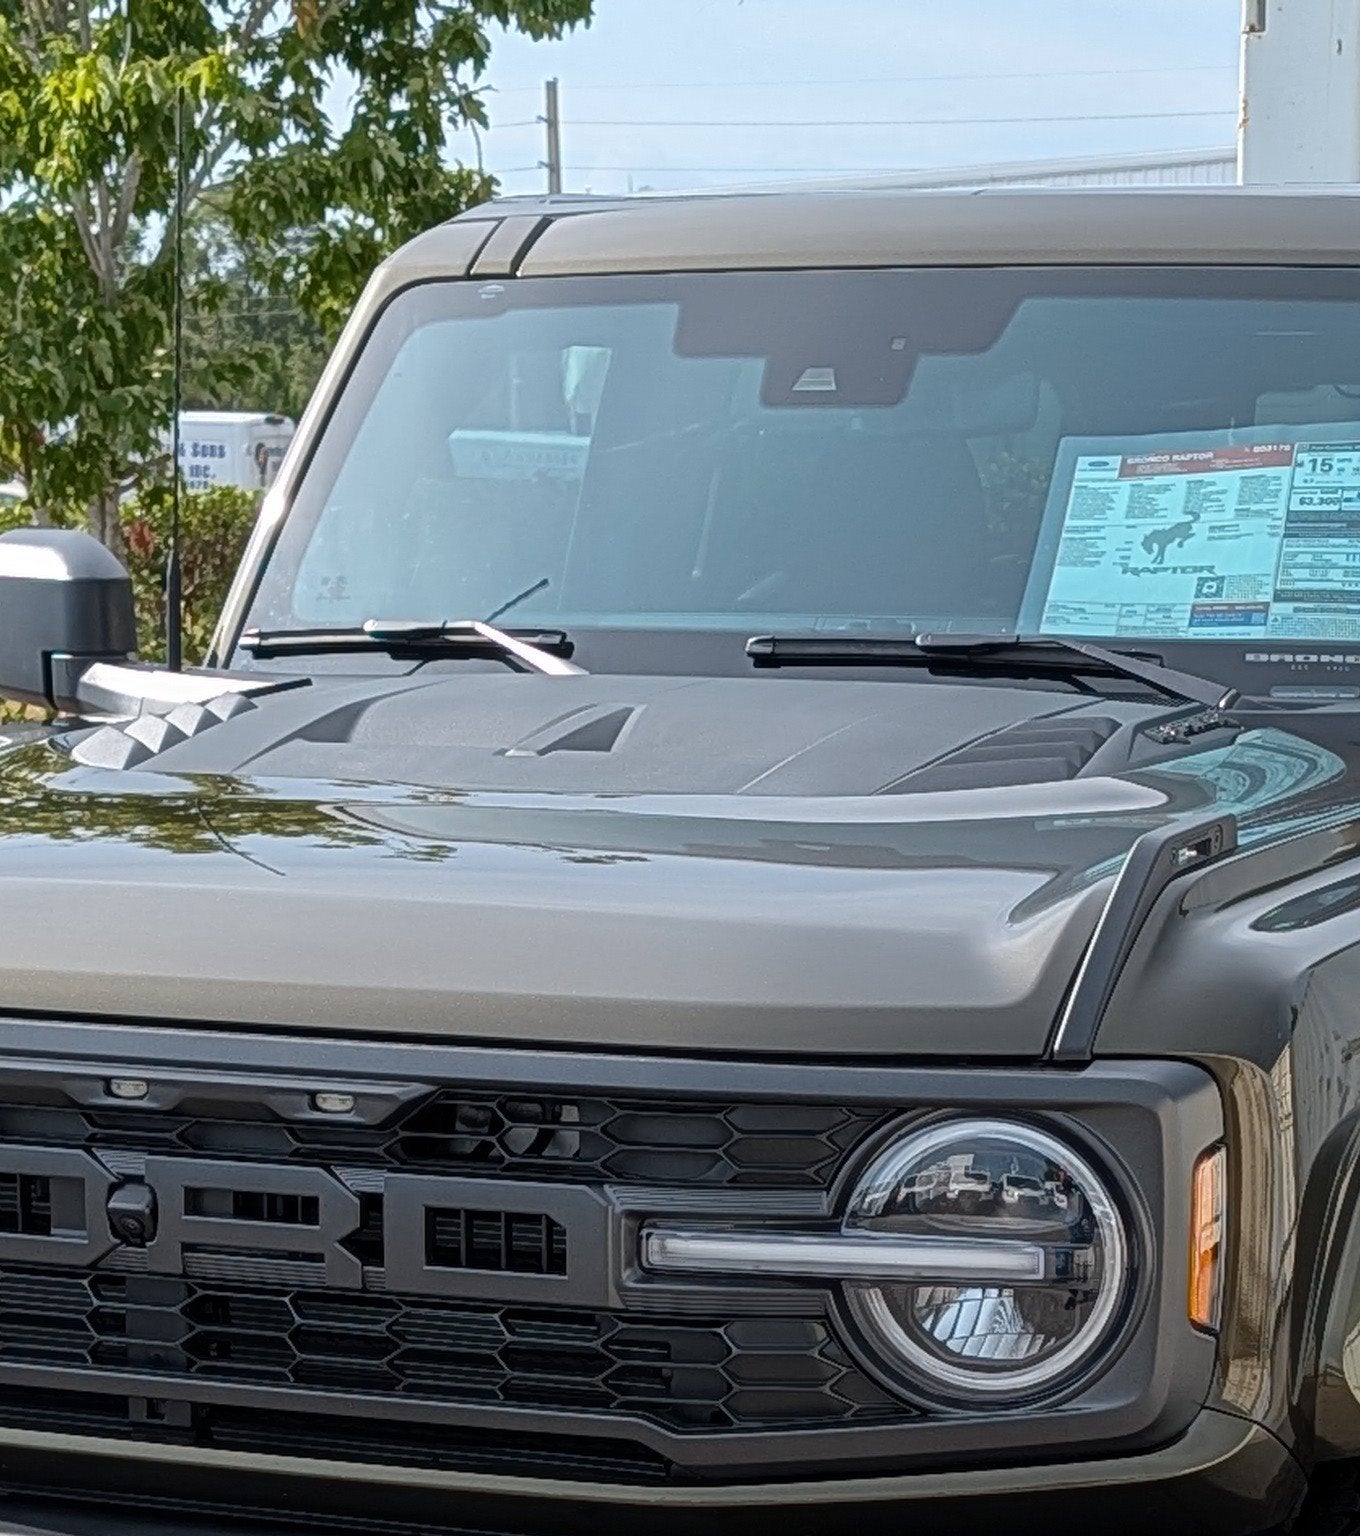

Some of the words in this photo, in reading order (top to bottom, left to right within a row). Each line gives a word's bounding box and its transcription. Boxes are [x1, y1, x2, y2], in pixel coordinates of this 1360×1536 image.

[1171, 451, 1215, 463] RAPTOR
[1308, 457, 1334, 473] 15
[1120, 563, 1218, 577] RAPTOR
